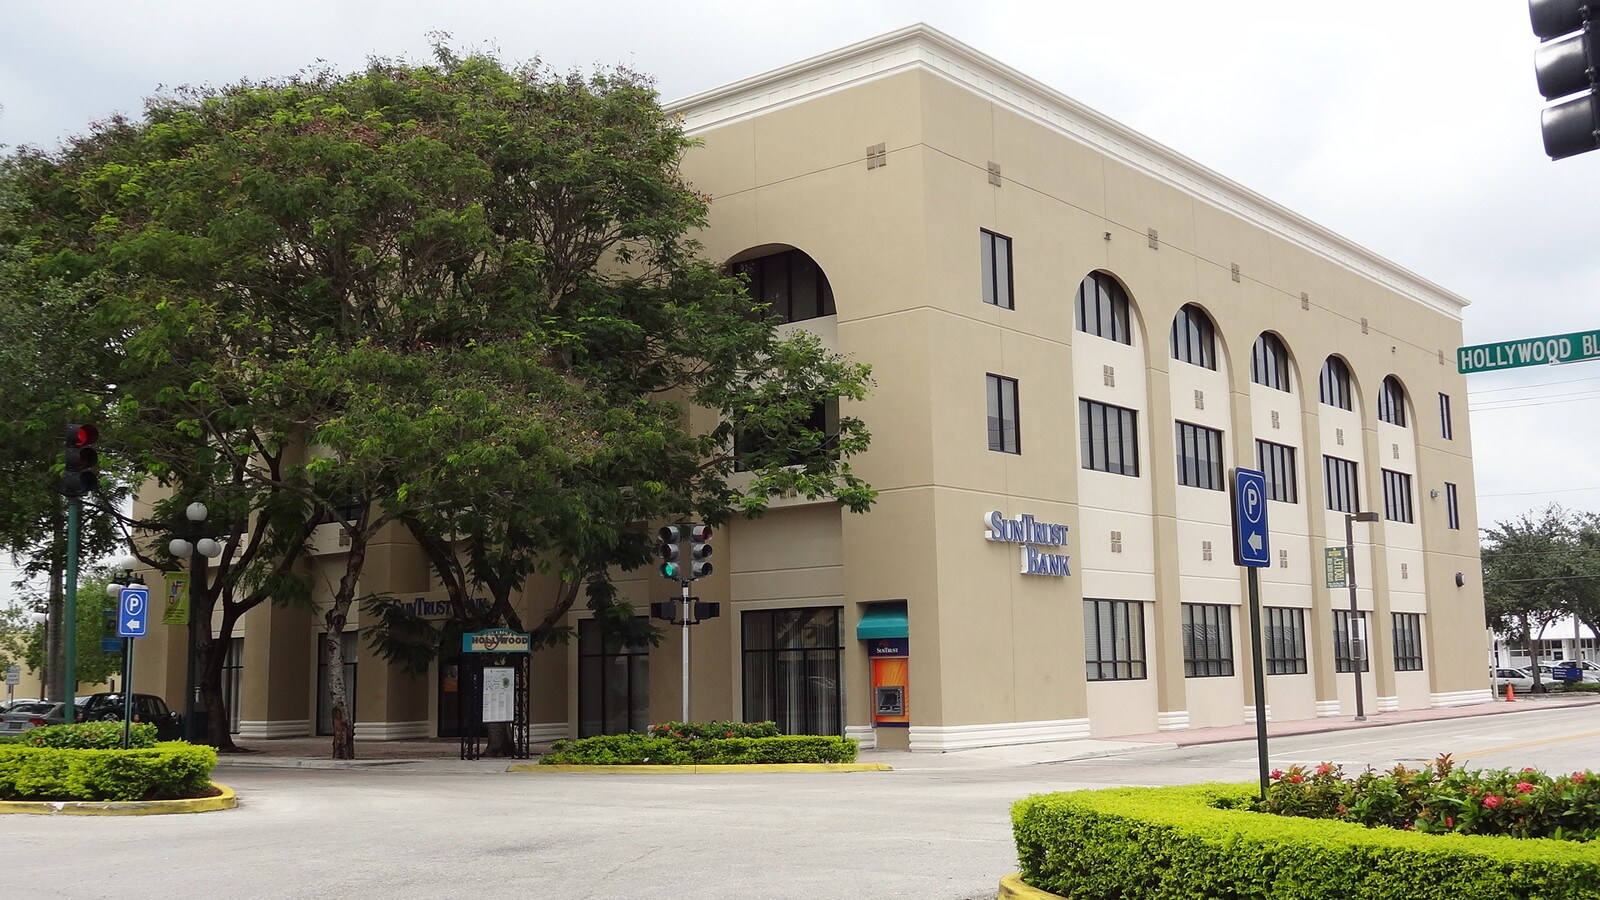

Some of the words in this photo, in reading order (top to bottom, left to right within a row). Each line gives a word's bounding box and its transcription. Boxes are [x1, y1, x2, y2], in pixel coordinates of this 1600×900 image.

[1460, 338, 1571, 370] HOLLYWOOD
[1247, 488, 1258, 515] P
[1333, 557, 1345, 582] TROLLEY
[129, 597, 140, 612] P
[471, 635, 528, 649] HOLLYWOOD
